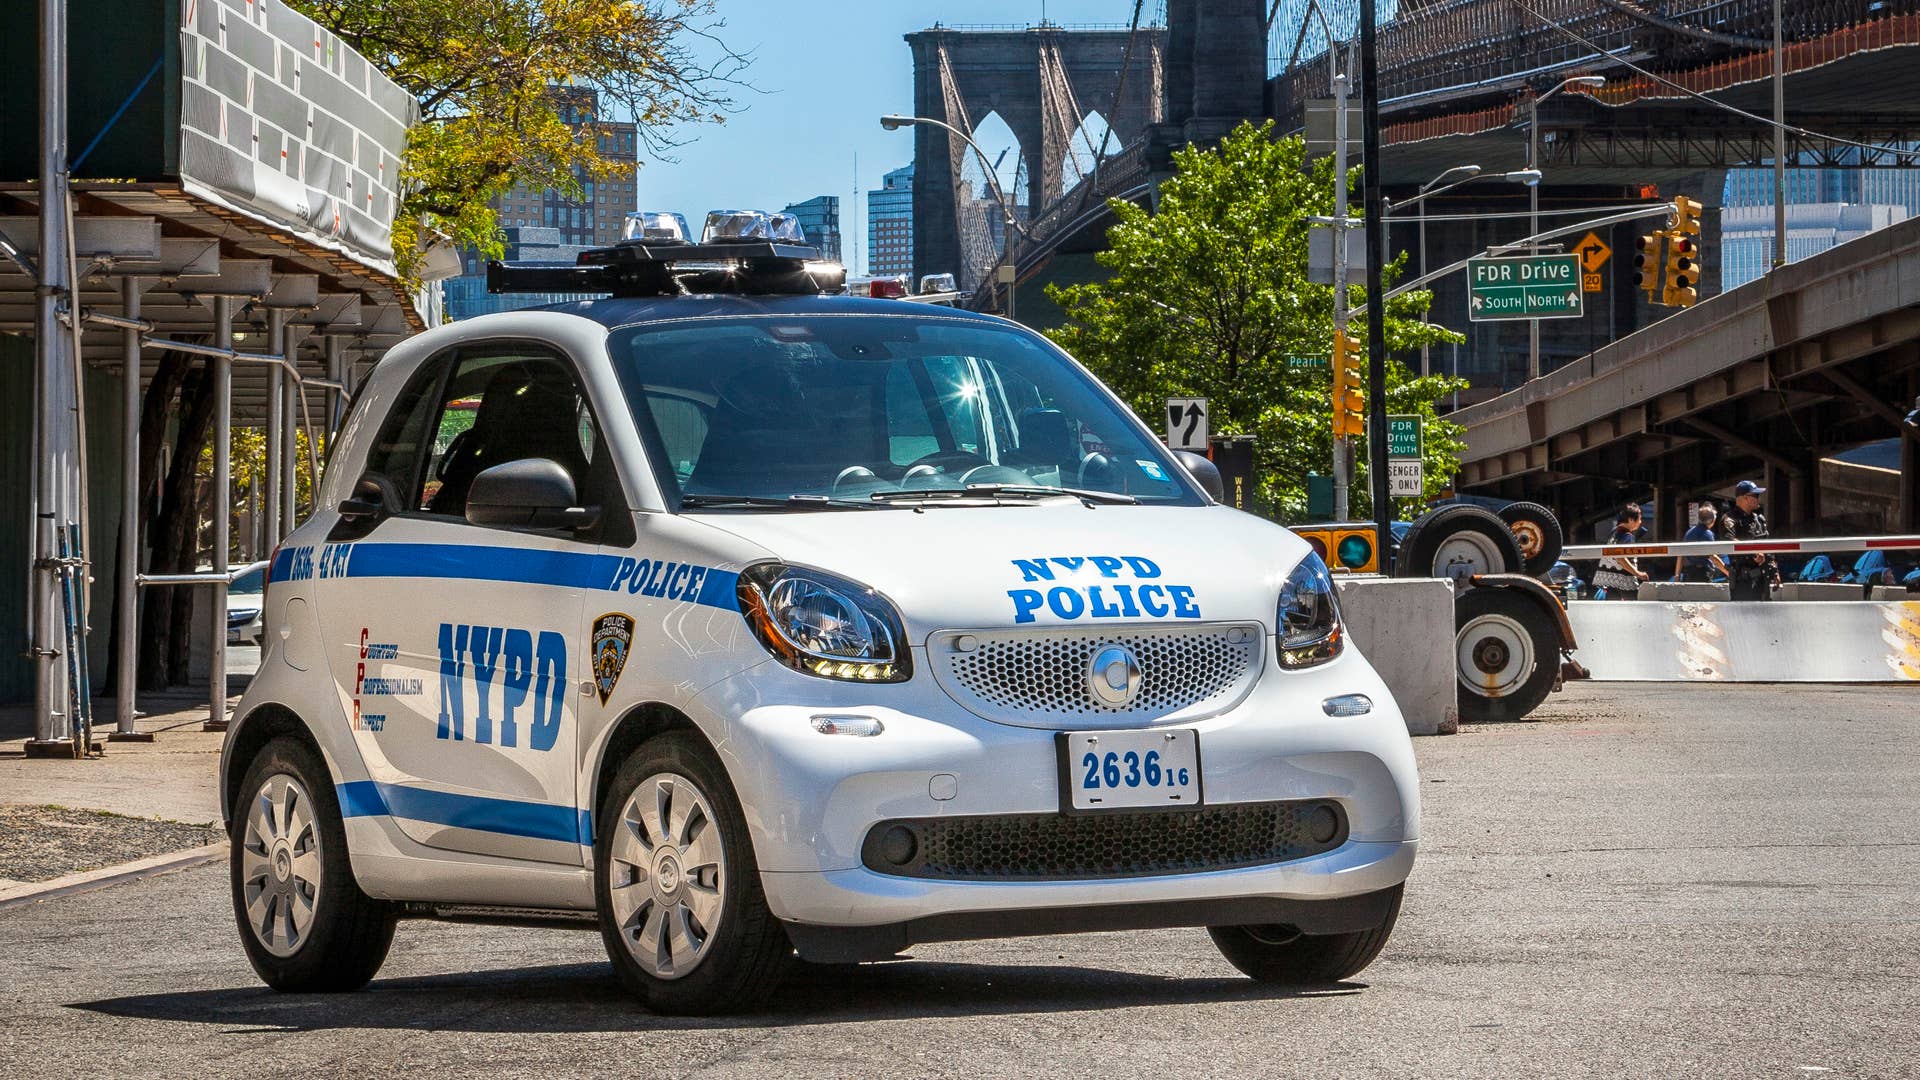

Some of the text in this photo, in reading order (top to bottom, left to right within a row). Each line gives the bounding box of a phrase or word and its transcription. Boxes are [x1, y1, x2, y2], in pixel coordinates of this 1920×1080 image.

[1477, 262, 1570, 281] FDR Drive
[1585, 275, 1600, 285] 20
[1486, 297, 1521, 309] SOUTH
[1528, 295, 1565, 307] NORTH
[1290, 355, 1317, 368] Pearl
[1391, 421, 1412, 431] FDR
[1387, 433, 1416, 442] Drive
[1387, 444, 1417, 454] SOUTH
[1388, 466, 1419, 477] SENGER
[1399, 480, 1419, 490] ONLY
[1011, 556, 1162, 582] NYPD
[609, 557, 706, 603] POLICE
[1007, 584, 1201, 624] POLICE
[602, 616, 626, 628] POLICE
[593, 626, 630, 643] DEPARTMENT
[356, 662, 423, 695] PROFESSIONALISM
[436, 623, 567, 752] NYPD
[1082, 750, 1189, 788] 2636 16
